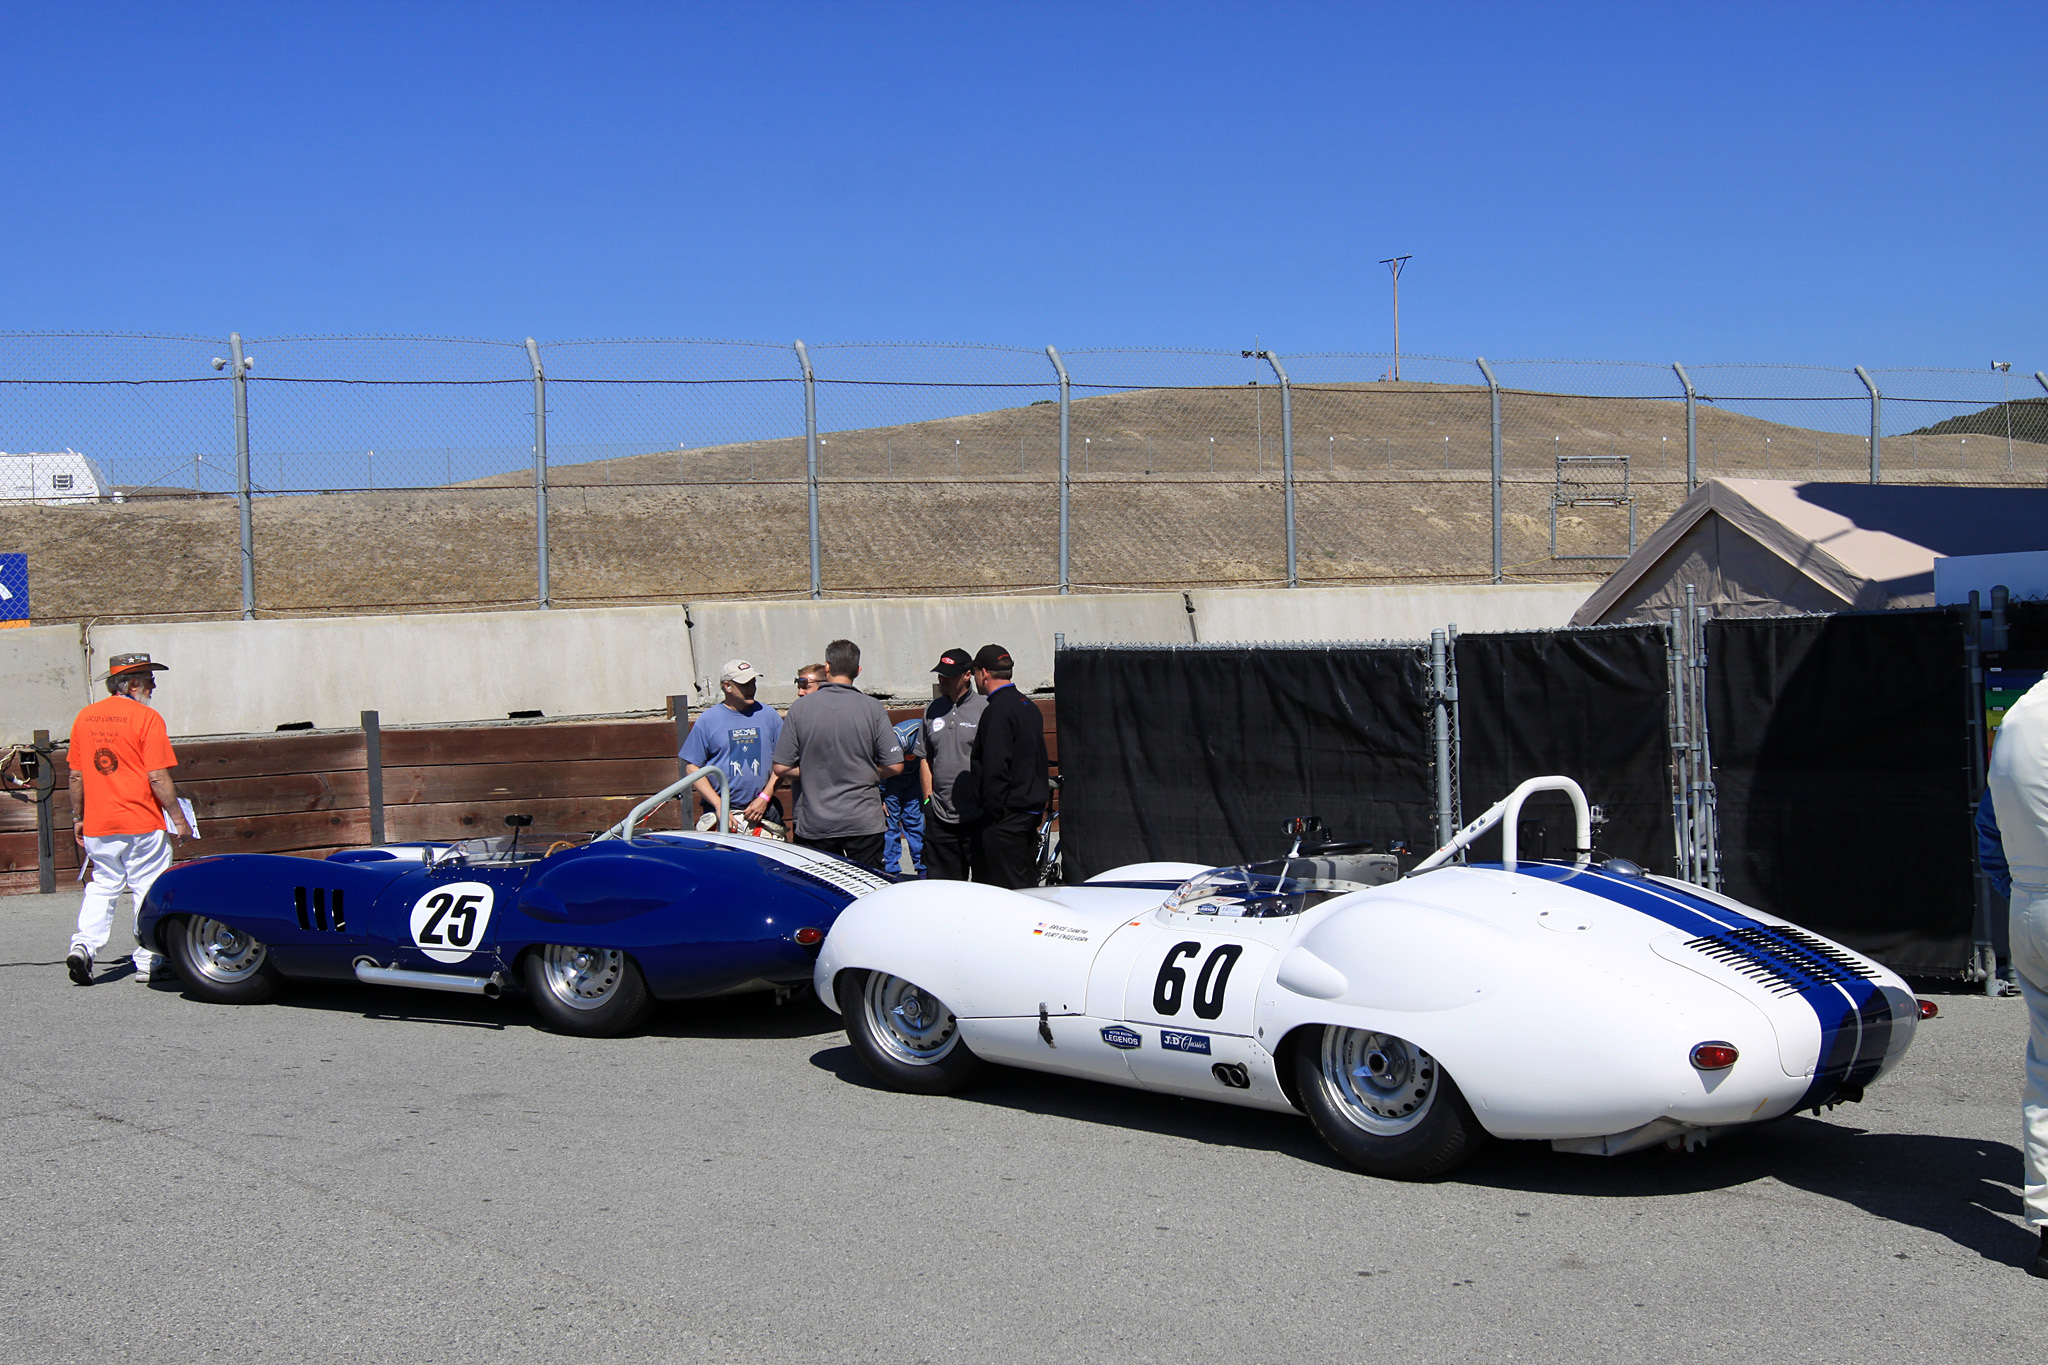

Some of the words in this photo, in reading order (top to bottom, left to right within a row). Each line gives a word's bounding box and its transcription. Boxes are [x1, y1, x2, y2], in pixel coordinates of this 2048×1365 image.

[419, 893, 485, 947] 25
[1153, 941, 1243, 1020] 60
[1104, 1034, 1139, 1045] LEGENDS
